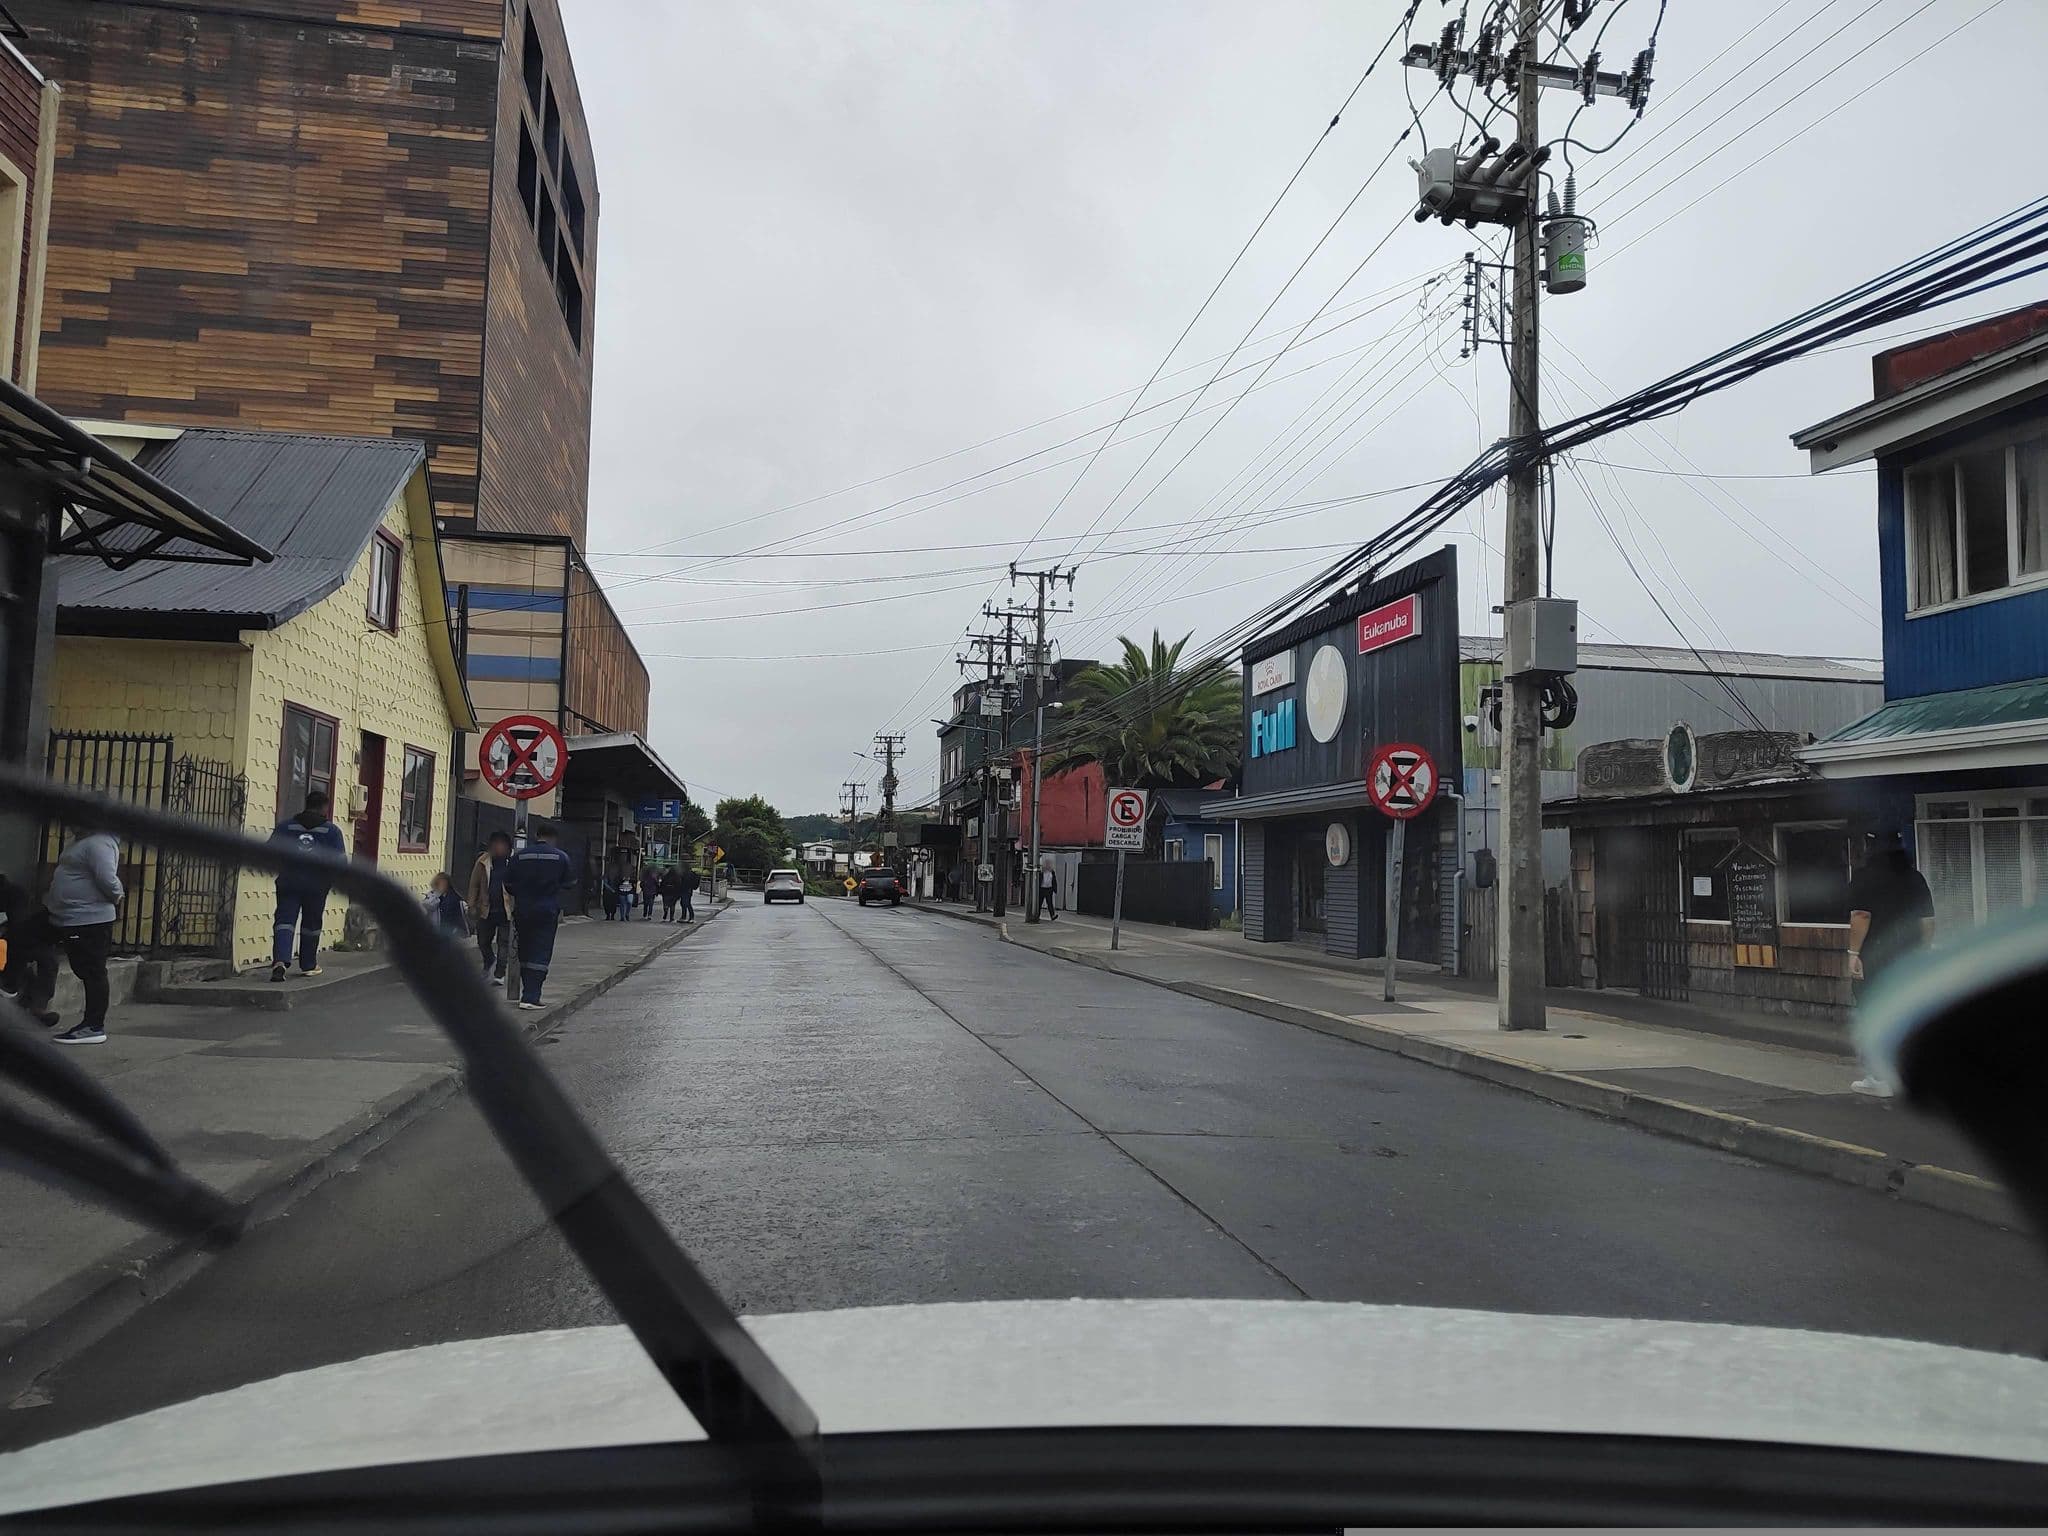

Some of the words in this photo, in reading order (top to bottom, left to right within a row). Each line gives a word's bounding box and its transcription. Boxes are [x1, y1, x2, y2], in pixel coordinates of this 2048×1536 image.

[1363, 613, 1408, 641] Eukanuba
[1252, 698, 1297, 758] Full
[662, 801, 674, 818] E
[1120, 799, 1135, 819] E
